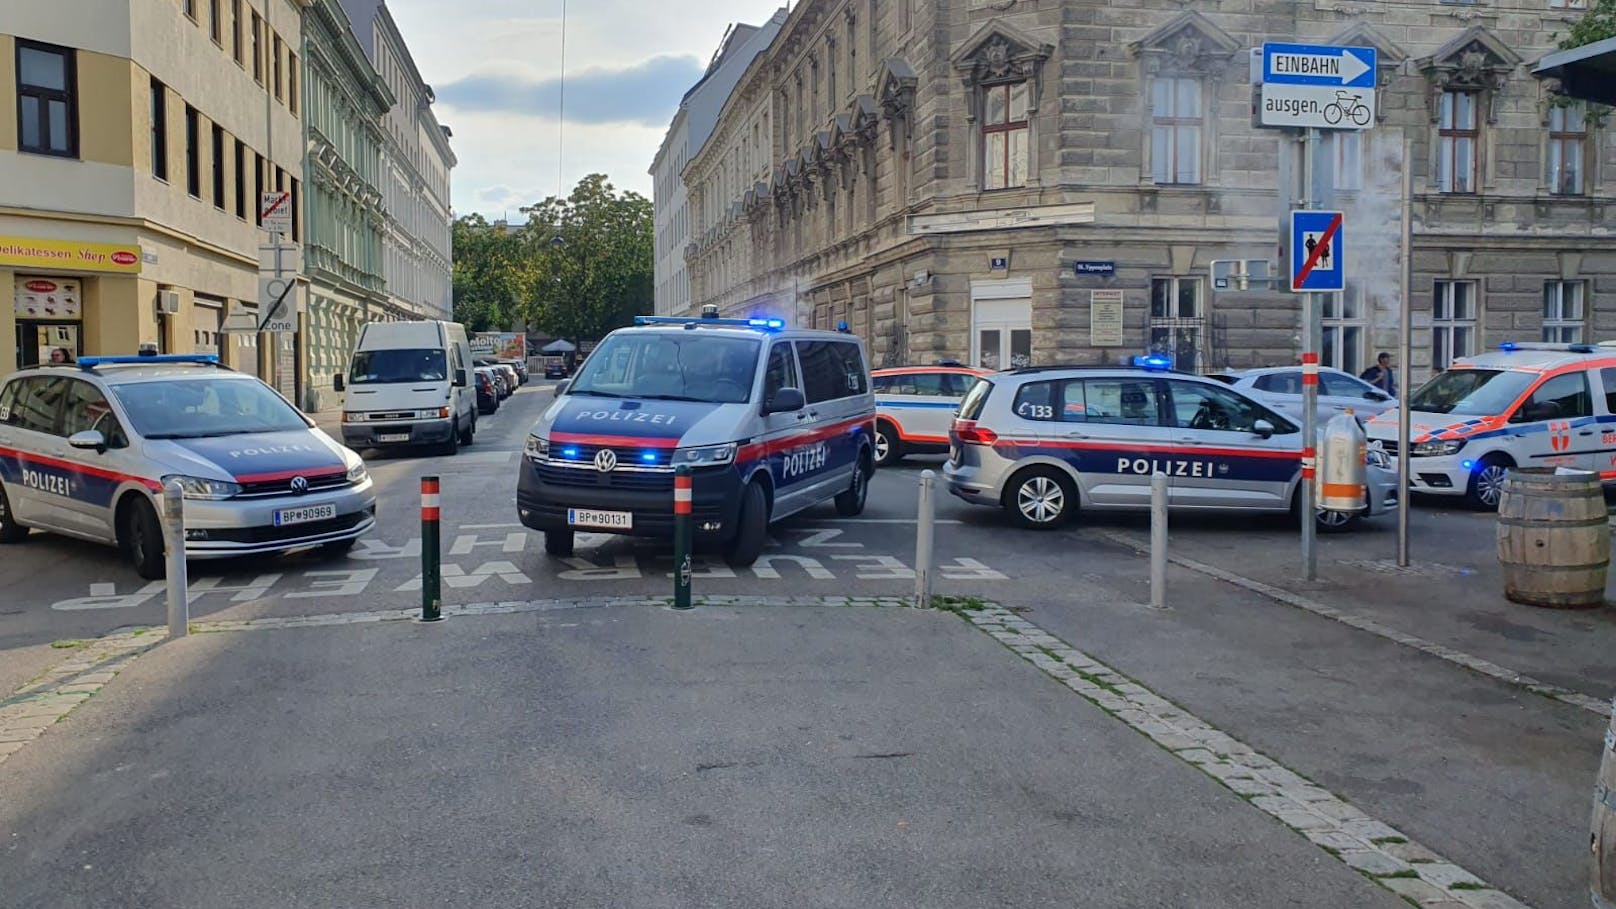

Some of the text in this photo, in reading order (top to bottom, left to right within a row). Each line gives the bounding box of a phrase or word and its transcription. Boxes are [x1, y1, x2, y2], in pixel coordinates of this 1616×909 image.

[1276, 55, 1340, 75] EINBAHN
[1266, 97, 1322, 117] ausgen.
[78, 249, 106, 264] Shop
[575, 411, 677, 425] POLIZEI
[1030, 404, 1053, 418] 133
[229, 445, 312, 458] POLIZEI
[783, 445, 826, 480] POLIZEI
[1117, 457, 1213, 478] POLIZEI
[22, 468, 70, 497] POLIZEI
[283, 506, 332, 522] BP 90969
[579, 512, 626, 525] BP 90131
